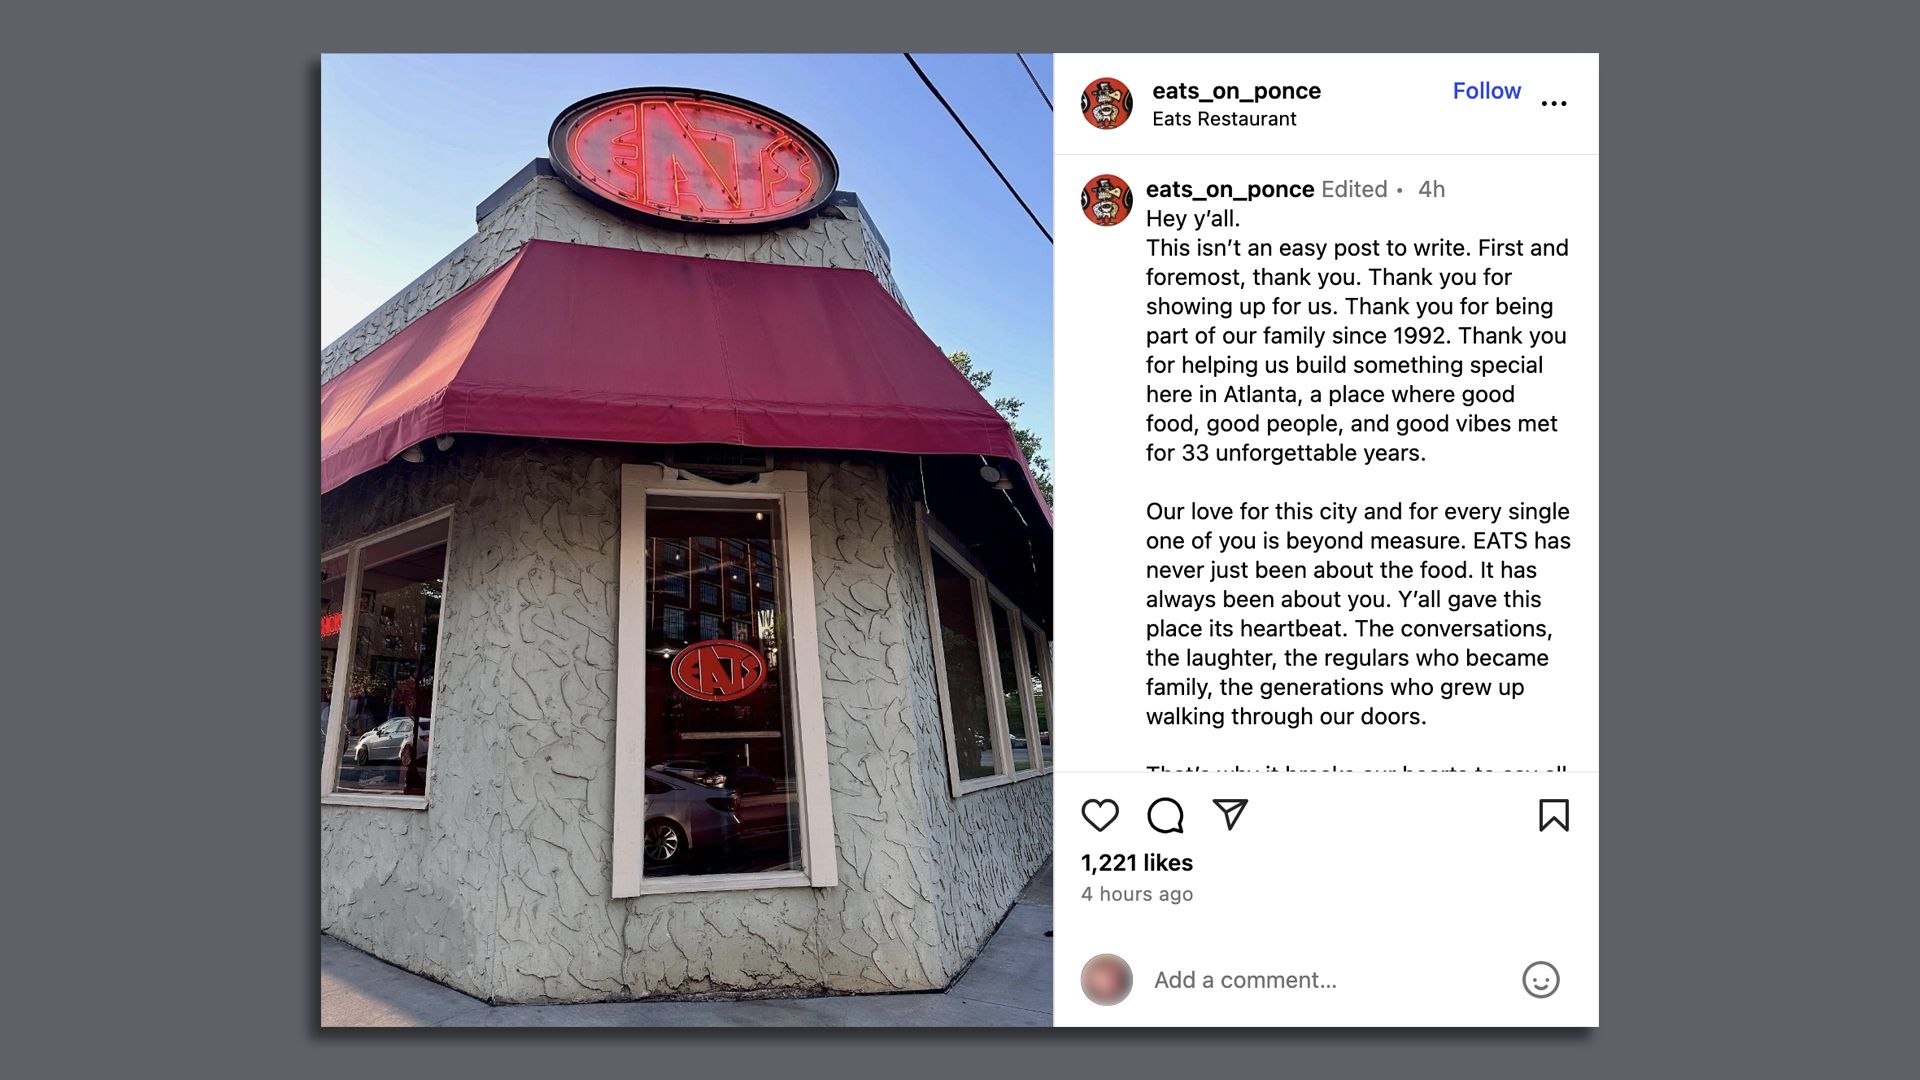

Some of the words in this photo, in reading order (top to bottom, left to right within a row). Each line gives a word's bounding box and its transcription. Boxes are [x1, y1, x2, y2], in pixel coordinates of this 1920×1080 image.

[1152, 82, 1322, 104] eats_on_ponce
[1453, 80, 1523, 100] Follow
[1153, 110, 1192, 127] Eats
[1198, 110, 1298, 127] Restaurant
[574, 101, 812, 213] EATS
[1145, 180, 1316, 202] eats_on_ponce
[1322, 179, 1388, 198] Edited
[1418, 179, 1445, 198] 4h
[1146, 209, 1188, 232] Hey
[1193, 208, 1240, 232] y’all.
[1145, 237, 1191, 257] This
[1197, 237, 1242, 257] isn’t
[1247, 242, 1273, 257] an
[1279, 242, 1328, 261] easy
[1334, 239, 1381, 261] post
[1385, 239, 1408, 257] to
[1413, 237, 1471, 257] write.
[1478, 237, 1524, 257] First
[1530, 237, 1569, 257] and
[1145, 267, 1246, 290] foremost,
[1252, 267, 1312, 286] thank
[1317, 271, 1361, 290] you.
[1367, 267, 1434, 286] Thank
[1438, 271, 1477, 291] you
[1482, 267, 1513, 286] for
[1146, 296, 1233, 320] showing
[1239, 301, 1266, 320] up
[1271, 296, 1302, 316] for
[1307, 301, 1338, 316] us.
[1344, 296, 1411, 316] Thank
[1415, 300, 1454, 320] you
[1459, 296, 1490, 316] for
[1495, 296, 1554, 320] being
[1146, 327, 1189, 349] part
[1194, 325, 1217, 345] of
[1222, 330, 1258, 345] our
[1262, 325, 1326, 349] family
[1332, 325, 1387, 345] since
[1393, 325, 1451, 345] 1992.
[1457, 325, 1523, 345] Thank
[1528, 330, 1567, 349] you
[1145, 354, 1176, 374] for
[1182, 354, 1258, 378] helping
[1264, 359, 1289, 374] us
[1296, 354, 1347, 374] build
[1353, 354, 1464, 378] something
[1470, 354, 1543, 378] special
[1146, 384, 1193, 404] here
[1199, 384, 1217, 403] in
[1223, 384, 1303, 407] Atlanta,
[1310, 388, 1322, 404] a
[1328, 384, 1385, 407] place
[1391, 384, 1456, 404] where
[1461, 384, 1515, 408] good
[1145, 413, 1199, 437] food,
[1206, 413, 1260, 437] good
[1267, 413, 1344, 437] people,
[1350, 413, 1389, 433] and
[1396, 413, 1449, 437] good
[1455, 413, 1512, 433] vibes
[1518, 415, 1559, 433] met
[1145, 442, 1176, 462] for
[1181, 443, 1210, 462] 33
[1215, 442, 1358, 466] unforgettable
[1363, 447, 1426, 466] years.
[1146, 501, 1186, 521] Our
[1191, 501, 1234, 521] love
[1239, 501, 1270, 521] for
[1274, 501, 1314, 521] this
[1319, 501, 1358, 525] city
[1363, 501, 1403, 521] and
[1408, 501, 1439, 521] for
[1444, 505, 1503, 525] every
[1508, 501, 1570, 525] single
[1146, 535, 1185, 550] one
[1191, 530, 1213, 550] of
[1218, 535, 1256, 554] you
[1263, 530, 1280, 550] is
[1286, 530, 1364, 554] beyond
[1370, 535, 1466, 550] measure.
[1473, 531, 1528, 550] EATS
[1534, 530, 1572, 550] has
[1146, 564, 1206, 579] never
[1209, 559, 1249, 583] just
[1255, 559, 1307, 579] been
[1313, 560, 1374, 579] about
[1379, 559, 1414, 579] the
[1419, 559, 1473, 579] food.
[1481, 560, 1495, 579] It
[1500, 559, 1538, 579] has
[1146, 589, 1217, 613] always
[1223, 589, 1275, 609] been
[1280, 589, 1342, 609] about
[1347, 593, 1391, 613] you.
[1397, 589, 1441, 609] Y’all
[1447, 593, 1498, 613] gave
[1503, 589, 1542, 609] this
[1146, 618, 1203, 642] place
[1209, 618, 1234, 638] its
[1240, 618, 1348, 638] heartbeat.
[1354, 618, 1395, 638] The
[1400, 618, 1553, 642] conversations,
[677, 644, 762, 695] EATS
[1145, 647, 1180, 667] the
[1186, 647, 1277, 671] laughter,
[1283, 647, 1318, 667] the
[1324, 647, 1410, 671] regulars
[1415, 647, 1460, 667] who
[1466, 647, 1550, 667] became
[1145, 677, 1213, 700] family,
[1219, 677, 1254, 696] the
[1259, 677, 1384, 700] generations
[1389, 677, 1434, 696] who
[1440, 681, 1493, 700] grew
[1498, 681, 1525, 700] up
[1145, 706, 1225, 730] walking
[1230, 706, 1313, 730] through
[1319, 711, 1355, 726] our
[1360, 706, 1427, 726] doors.
[1081, 853, 1136, 876] 1,221
[1144, 852, 1194, 872] likes
[1081, 886, 1093, 902] 4
[1100, 885, 1153, 902] hours
[1159, 889, 1194, 906] ago
[1154, 970, 1196, 989] Add
[1202, 974, 1214, 989] a
